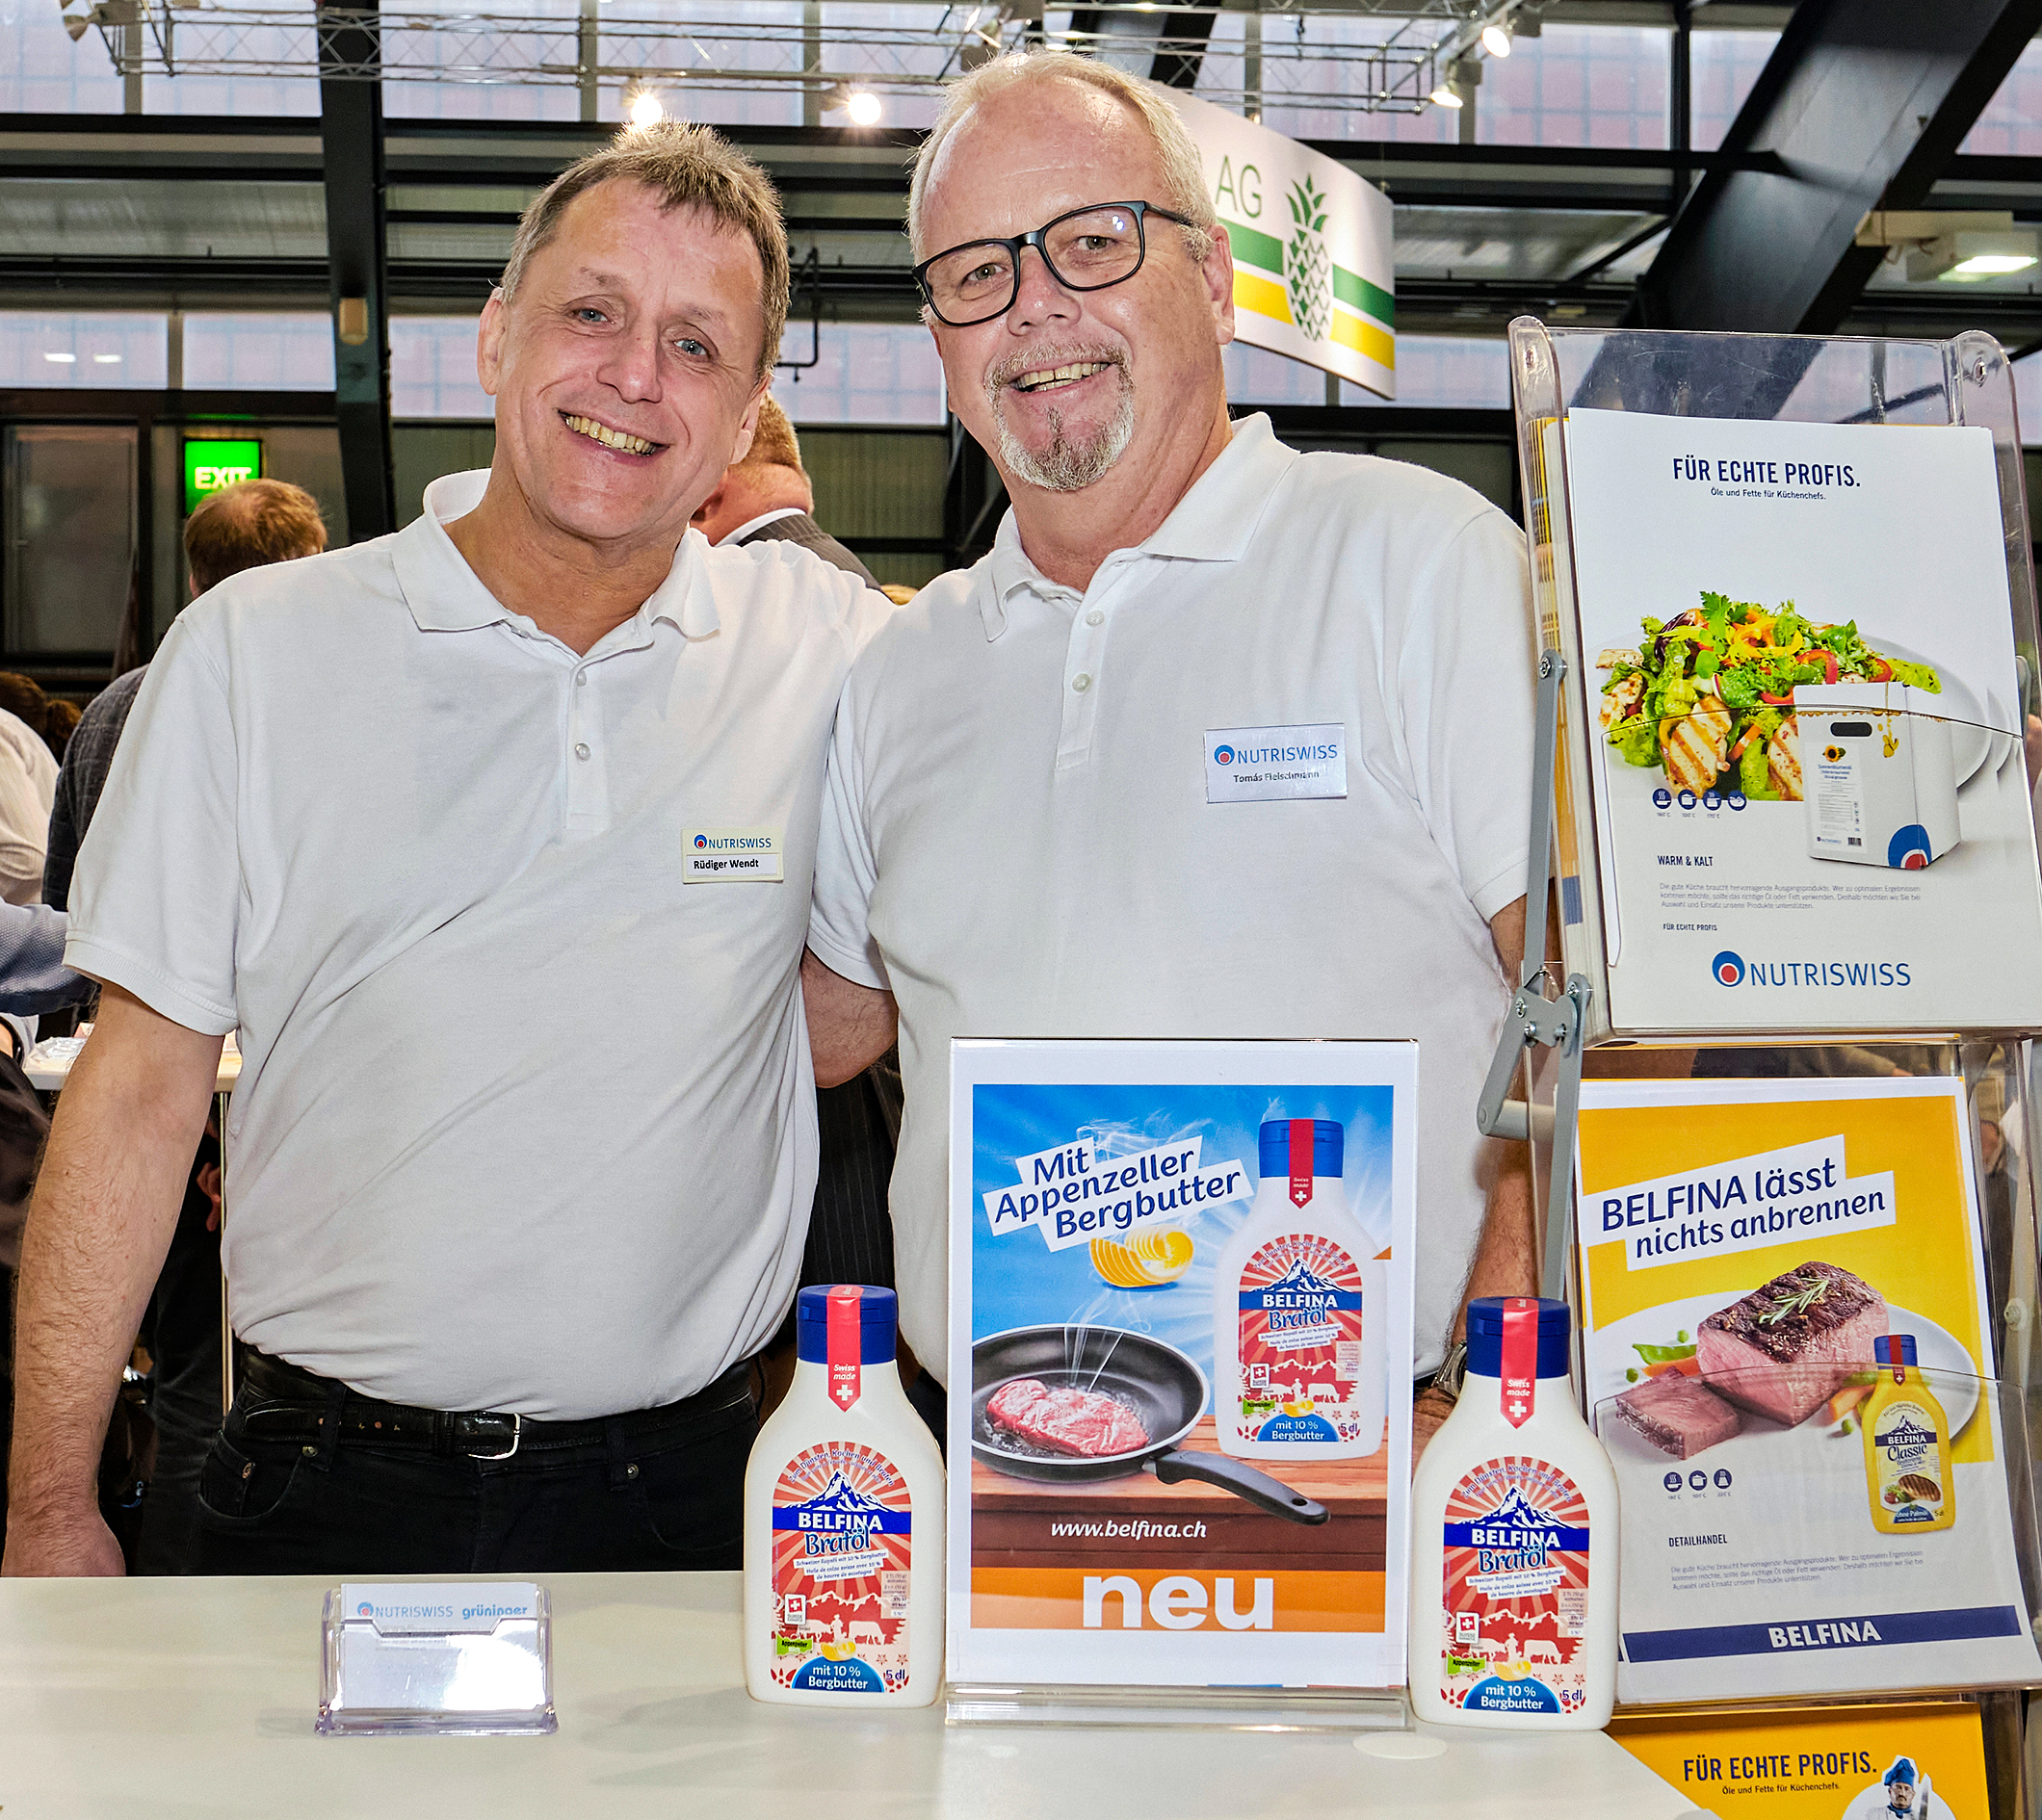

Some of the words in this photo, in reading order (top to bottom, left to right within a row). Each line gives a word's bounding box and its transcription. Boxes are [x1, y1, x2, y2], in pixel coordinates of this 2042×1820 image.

[1216, 155, 1262, 219] AG
[195, 467, 251, 489] EXIT
[1673, 455, 1711, 481] FÜR
[1718, 460, 1778, 482] ECHTE
[1785, 462, 1861, 486] PROFIS.
[1711, 487, 1724, 496] Öle
[1777, 490, 1826, 500] Küchenchefs.
[1238, 744, 1338, 764] NUTRISWISS
[1234, 773, 1263, 783] Tomás
[709, 838, 772, 848] NUTRISWISS
[694, 860, 727, 871] Rüdiger
[729, 859, 759, 868] Wendt
[1658, 856, 1683, 865] WARM
[1686, 856, 1691, 866] &
[1694, 856, 1713, 867] KALT
[1750, 963, 1911, 986] NUTRISWISS
[1033, 1146, 1089, 1186] Mit
[994, 1149, 1195, 1224] Appenzeller
[1602, 1175, 1747, 1232] BELFINA
[1754, 1157, 1837, 1201] lässt
[1056, 1169, 1242, 1238] Bergbutter
[1636, 1222, 1724, 1259] nichts
[1730, 1190, 1886, 1239] anbrennen
[1263, 1294, 1338, 1308] BELFINA
[1269, 1305, 1326, 1330] Bratöl
[1507, 1379, 1530, 1388] Swiss
[1275, 1420, 1293, 1430] mit
[1295, 1421, 1305, 1430] 10
[1308, 1421, 1319, 1430] %
[1272, 1431, 1324, 1442] Bergbutter
[1888, 1435, 1926, 1444] BELFINA
[1887, 1444, 1927, 1461] Classic
[798, 1512, 883, 1531] BELFINA
[1051, 1520, 1207, 1541] www.belfina.ch
[1472, 1528, 1560, 1547] BELFINA
[805, 1525, 870, 1555] Bratöl
[1668, 1534, 1728, 1547] DETAILHANDEL
[1479, 1542, 1546, 1573] Bratöl
[1082, 1575, 1274, 1630] neu
[375, 1606, 453, 1618] NUTRISWISS
[1767, 1621, 1882, 1649] BELFINA
[813, 1665, 831, 1676] mit
[834, 1666, 847, 1677] 10
[850, 1666, 861, 1677] %
[885, 1670, 893, 1680] 5
[895, 1669, 905, 1680] dl
[808, 1676, 868, 1689] Bergbutter
[1485, 1685, 1505, 1697] mit
[1507, 1685, 1522, 1697] 10
[1524, 1686, 1536, 1697] %
[1480, 1696, 1544, 1710] Bergbutter
[1562, 1690, 1569, 1701] 5
[1572, 1689, 1582, 1701] dl
[1684, 1755, 1722, 1781] FÜR
[1730, 1755, 1792, 1780] ECHTE
[1799, 1752, 1877, 1776] PROFIS.
[1722, 1785, 1736, 1795] Öle
